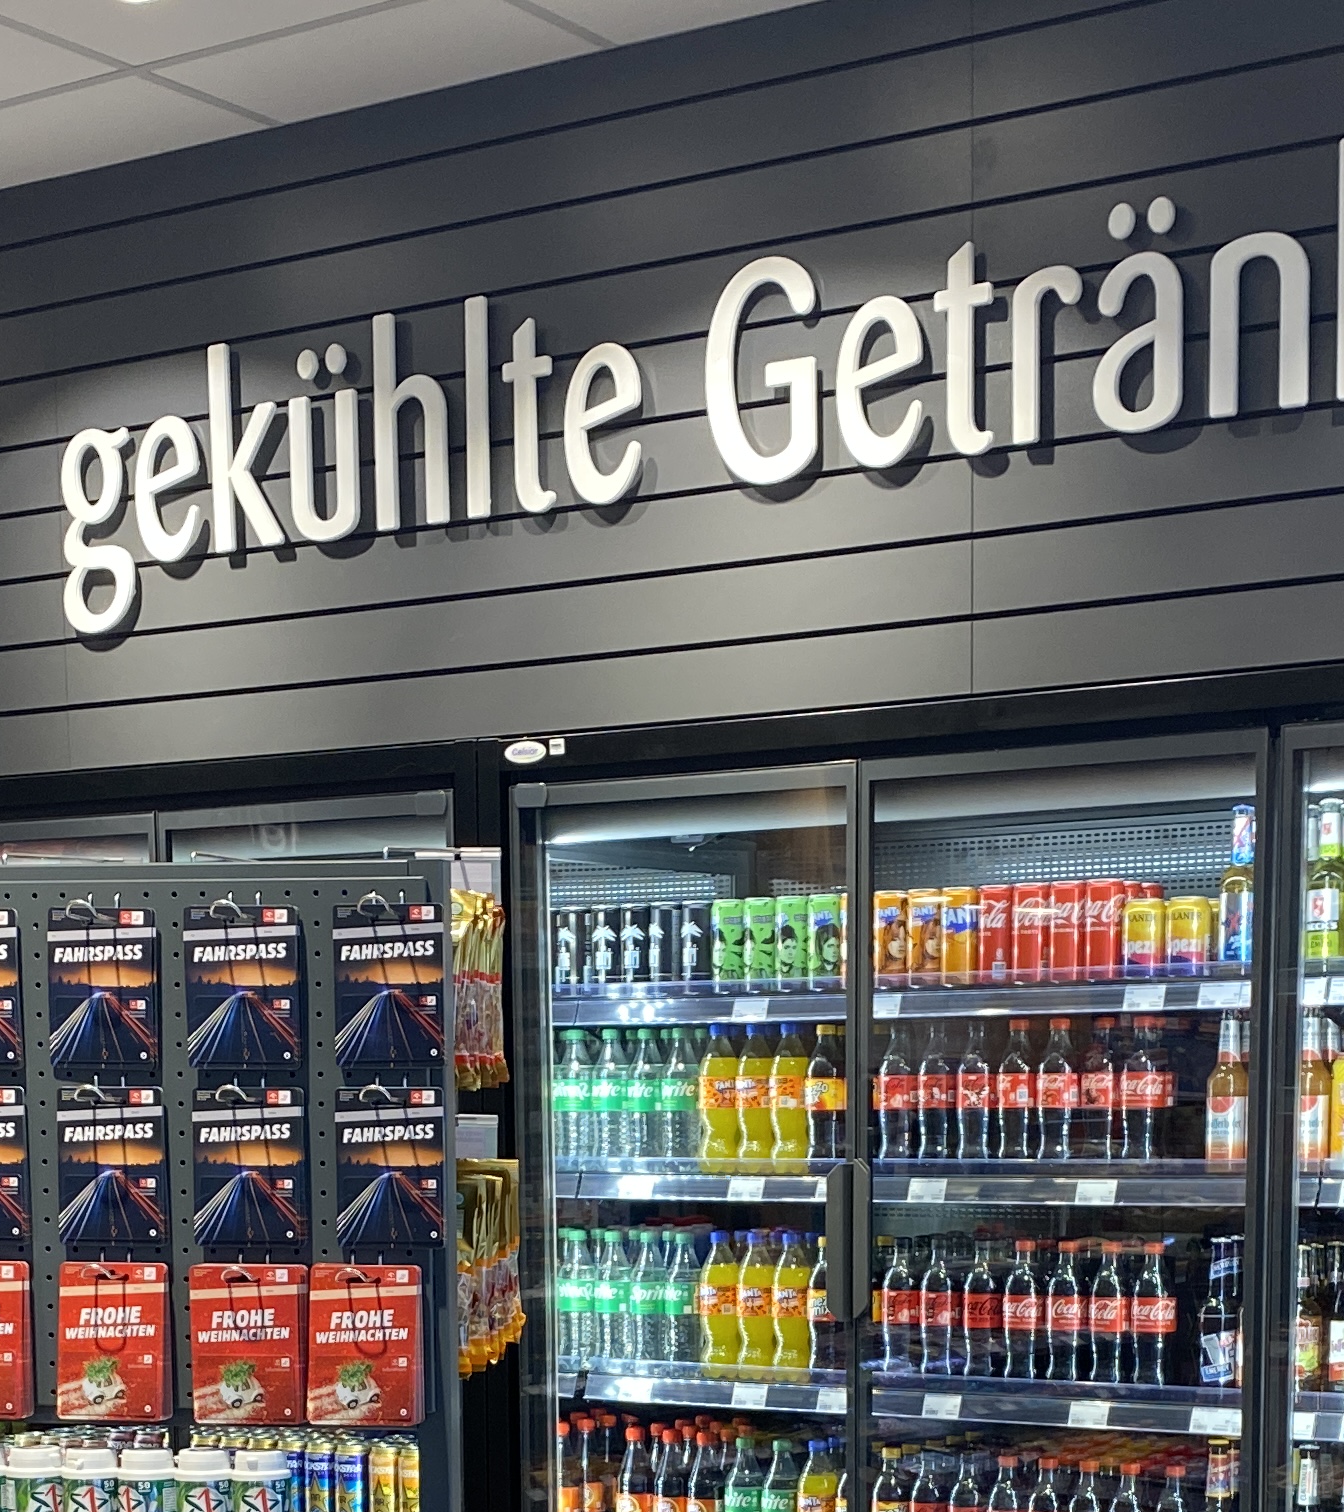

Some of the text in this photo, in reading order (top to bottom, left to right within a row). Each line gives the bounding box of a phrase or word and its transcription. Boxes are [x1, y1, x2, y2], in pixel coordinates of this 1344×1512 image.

[61, 296, 641, 634] gekühlte
[53, 943, 143, 963] FAHRSPASS
[193, 942, 288, 963] FAHRSPASS
[339, 940, 435, 962] FAHRSPASS
[63, 1122, 154, 1143] FAHRSPASS
[199, 1123, 291, 1143] FAHRSPASS
[342, 1123, 435, 1144] FAHRSPASS
[79, 1306, 142, 1324] FROHE
[211, 1309, 275, 1328] FROHE
[329, 1309, 395, 1329] FROHE
[65, 1325, 155, 1340] WEIHNACHTEN
[197, 1327, 290, 1343] WEIHNACHTEN
[315, 1327, 409, 1344] WEIHNACHTEN
